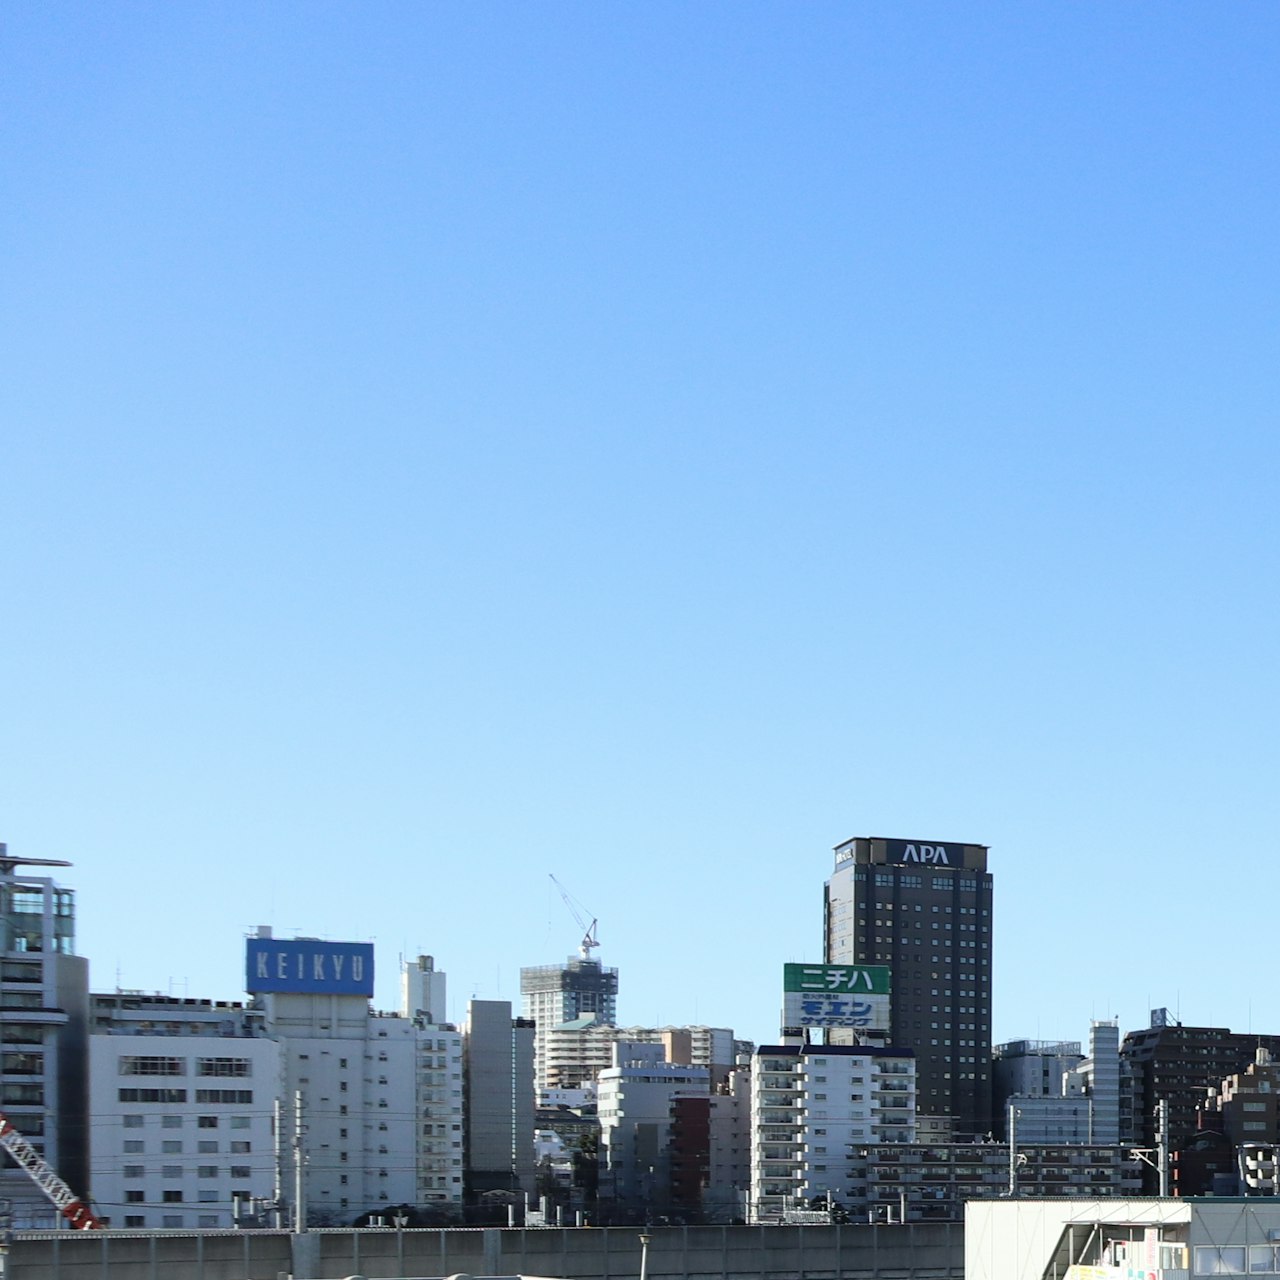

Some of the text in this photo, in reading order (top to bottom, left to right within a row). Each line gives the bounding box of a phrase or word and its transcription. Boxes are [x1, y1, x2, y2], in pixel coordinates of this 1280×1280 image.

[902, 844, 949, 865] APA
[257, 952, 363, 981] KEIKYU
[801, 969, 873, 990] ニチハ
[801, 1001, 872, 1016] モエン
